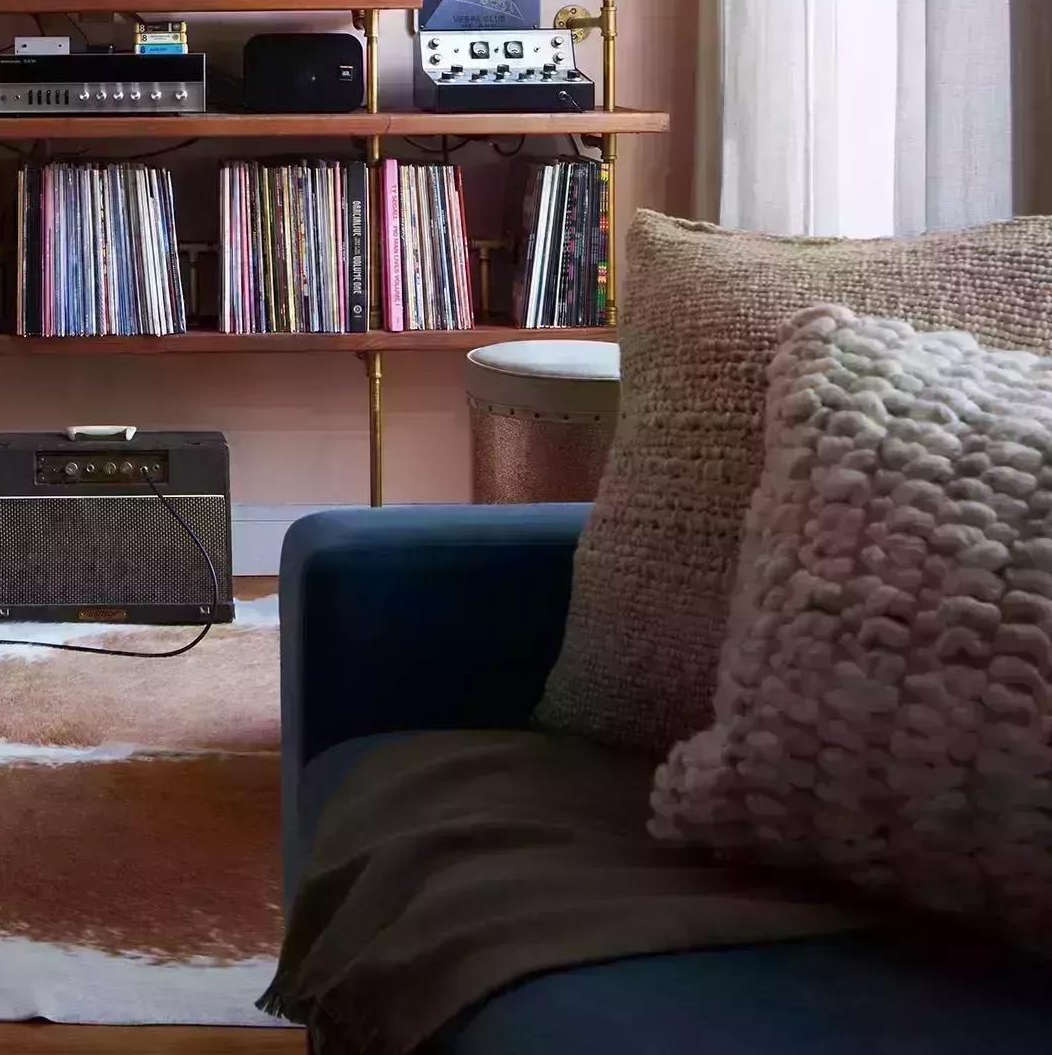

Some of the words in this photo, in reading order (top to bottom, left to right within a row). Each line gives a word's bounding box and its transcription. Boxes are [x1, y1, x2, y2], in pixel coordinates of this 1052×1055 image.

[452, 15, 480, 23] VESPA
[483, 15, 506, 23] CLUB
[391, 184, 397, 193] TY
[353, 255, 362, 281] VOLUME
[353, 281, 362, 294] ONE
